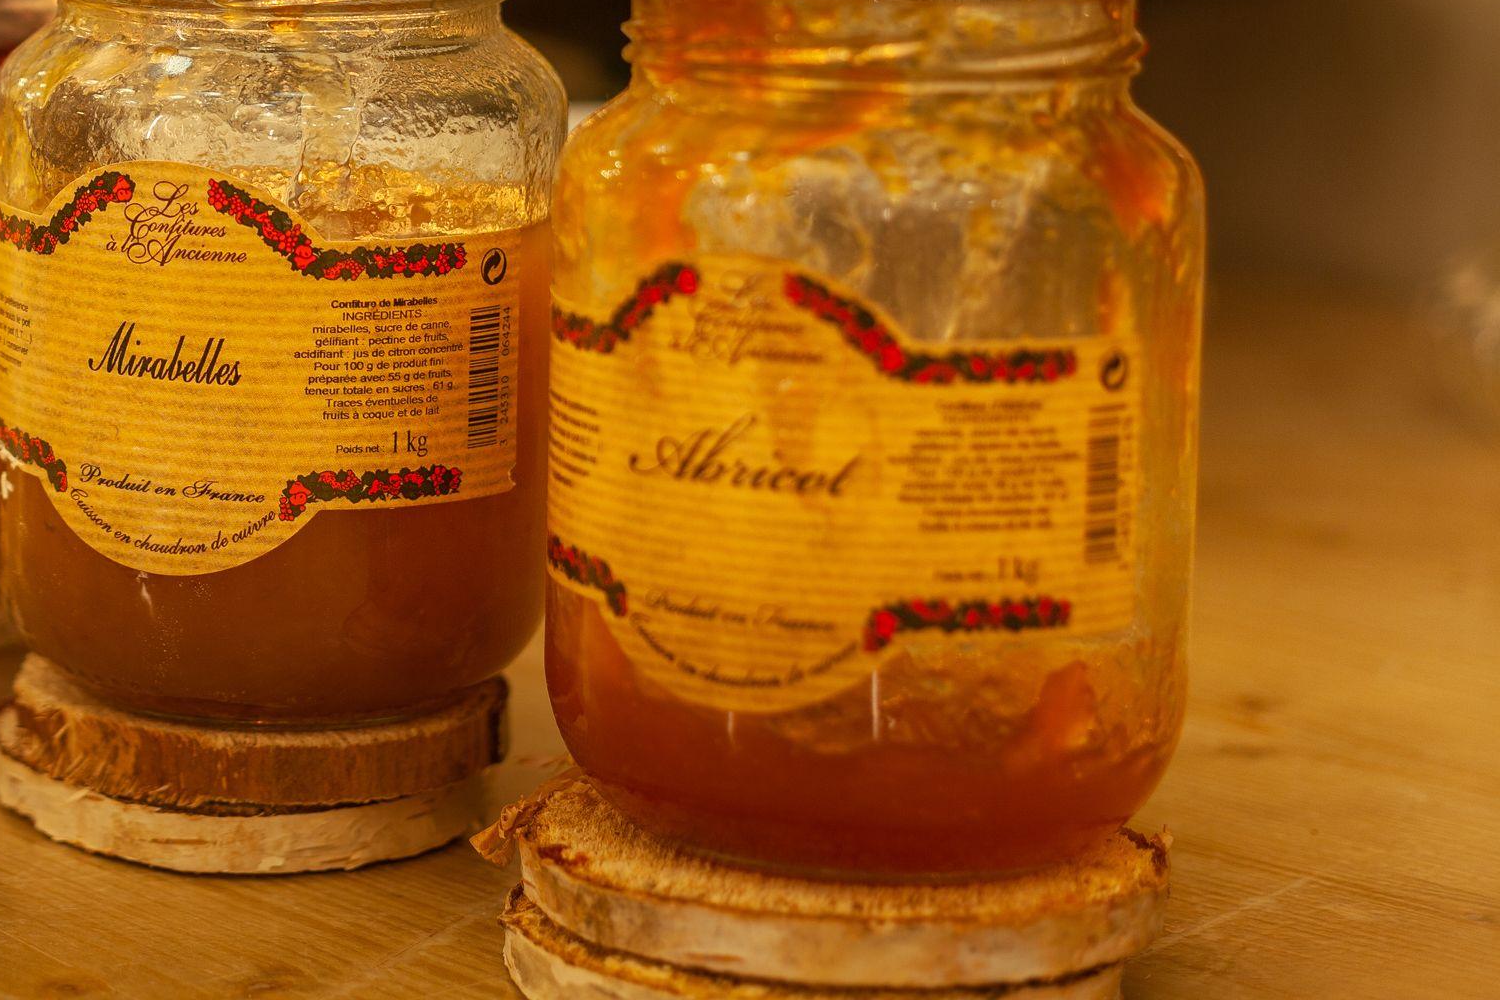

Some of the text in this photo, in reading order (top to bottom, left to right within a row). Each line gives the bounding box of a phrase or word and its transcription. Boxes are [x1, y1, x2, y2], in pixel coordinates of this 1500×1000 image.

[153, 181, 199, 218] Les
[124, 202, 226, 241] Confitures
[331, 297, 438, 309] Confiture de Mirabelles
[312, 325, 371, 335] mirabelles,
[375, 323, 402, 333] sucre
[405, 322, 418, 332] de
[315, 336, 359, 348] gélifiant
[368, 335, 406, 347] pectine
[408, 333, 421, 343] de
[89, 321, 242, 387] Mirabelles
[293, 349, 344, 359] acidifiant
[353, 349, 369, 360] jus
[371, 347, 385, 358] de
[388, 345, 416, 356] citron
[314, 361, 340, 371] Pour
[343, 361, 364, 371] 100
[366, 362, 374, 372] g
[376, 359, 390, 370] de
[392, 357, 428, 370] produit
[308, 374, 357, 385] préparée
[360, 374, 385, 384] avec
[387, 372, 401, 382] 55
[403, 373, 410, 383] g
[412, 370, 426, 380] de
[304, 386, 340, 396] teneur
[342, 385, 373, 395] totale
[375, 385, 389, 395] en
[392, 383, 425, 394] sucres
[325, 394, 438, 408] Traces éventuelles de
[322, 405, 440, 421] fruits à coque et de lait
[335, 444, 363, 454] Poids
[391, 430, 398, 454] 1
[406, 429, 429, 458] kg
[629, 413, 862, 497] Abricot
[80, 463, 265, 504] Produit en France
[70, 486, 276, 556] Cuisson en chaudron de cuivre
